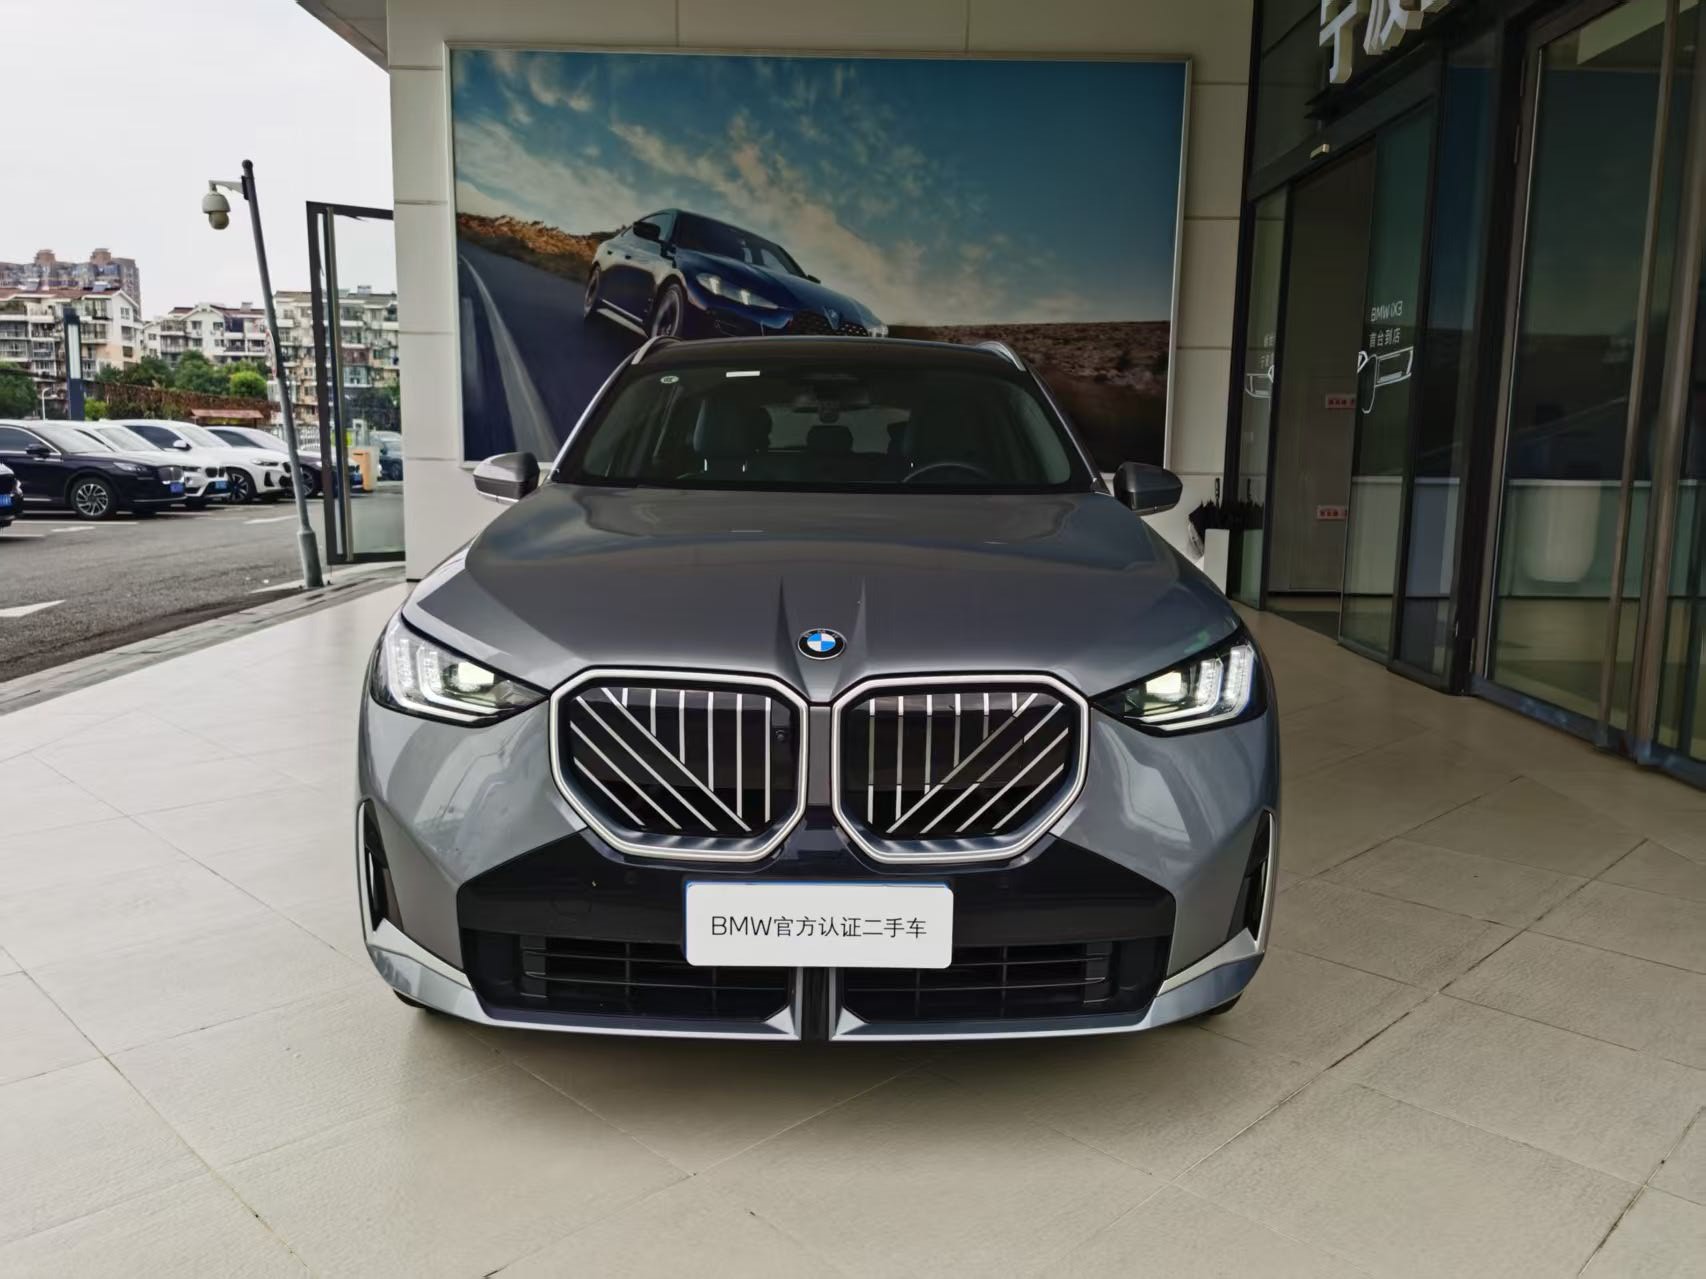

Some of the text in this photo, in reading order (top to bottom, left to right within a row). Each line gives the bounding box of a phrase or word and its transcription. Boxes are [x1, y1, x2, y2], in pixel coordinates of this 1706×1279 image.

[1371, 304, 1391, 322] BMW
[711, 916, 927, 938] BMW官方认证二手车
